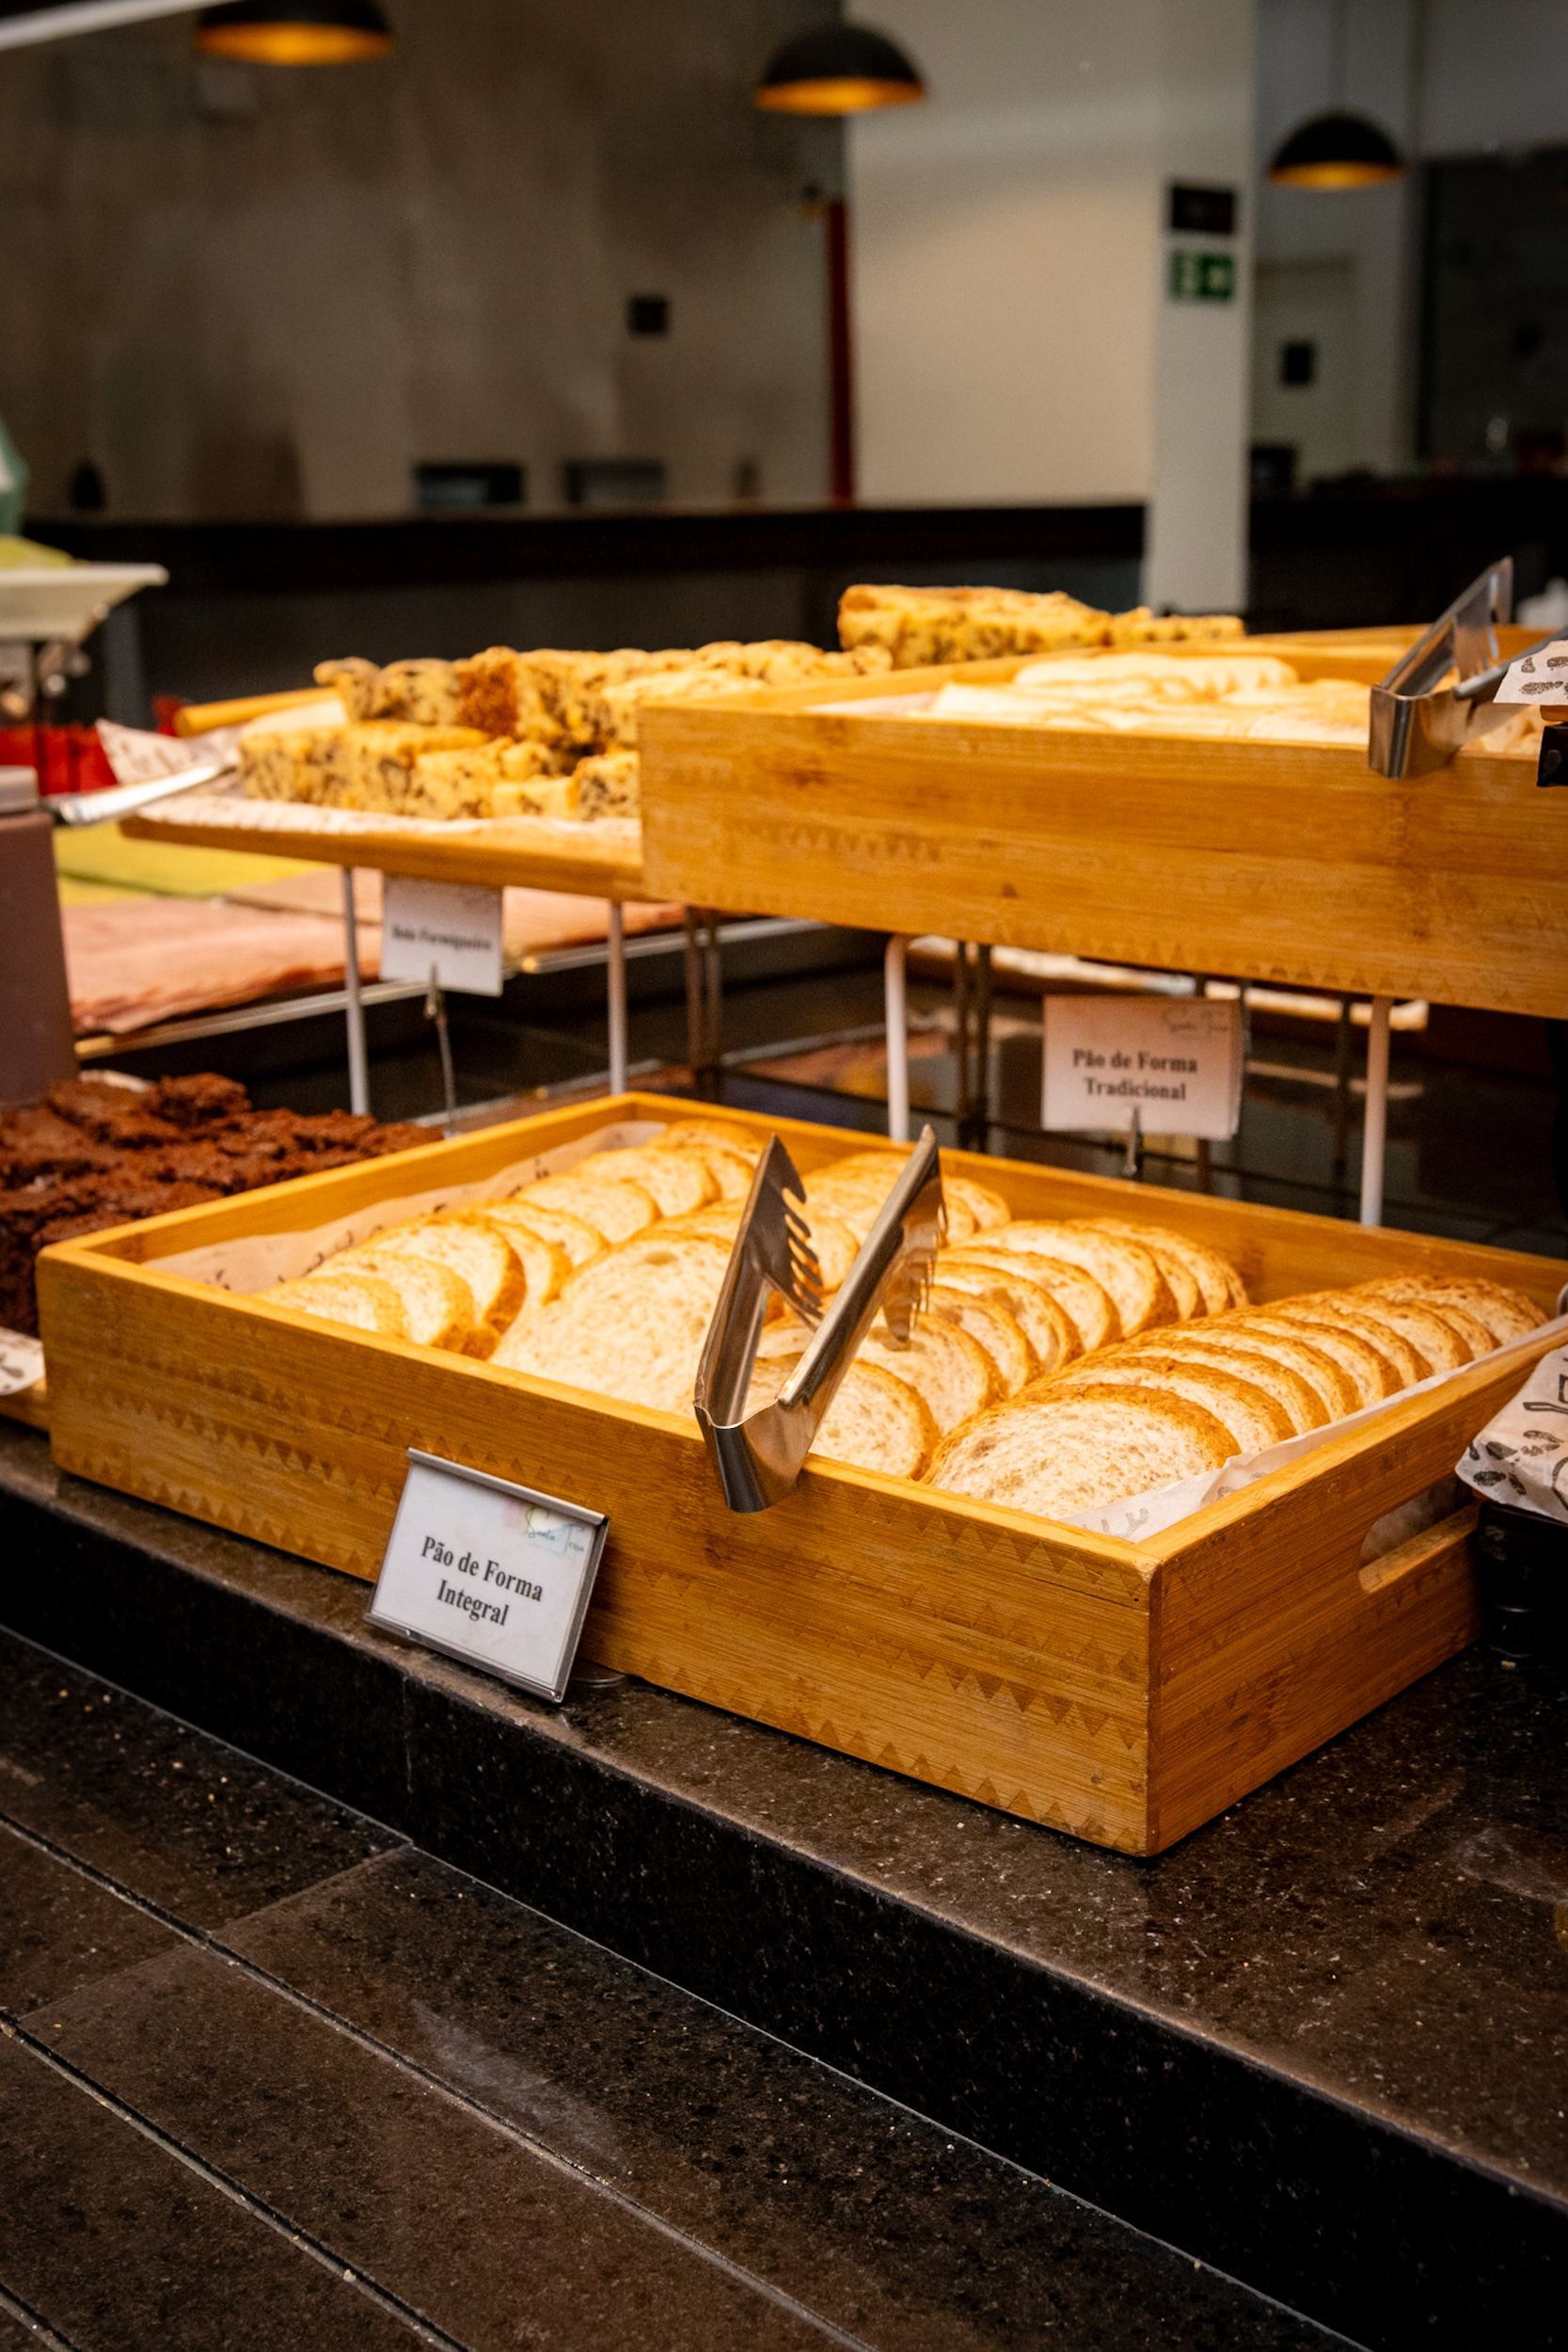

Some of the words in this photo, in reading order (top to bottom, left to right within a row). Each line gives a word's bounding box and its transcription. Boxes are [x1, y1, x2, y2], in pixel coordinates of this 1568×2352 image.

[1072, 1048, 1106, 1068] Pão
[1111, 1052, 1132, 1070] de
[1137, 1052, 1198, 1073] Forma
[1085, 1077, 1187, 1101] Tradicional
[420, 1535, 454, 1566] Pão
[458, 1551, 480, 1577] de
[483, 1559, 544, 1601] Forma
[436, 1579, 510, 1626] Integral
